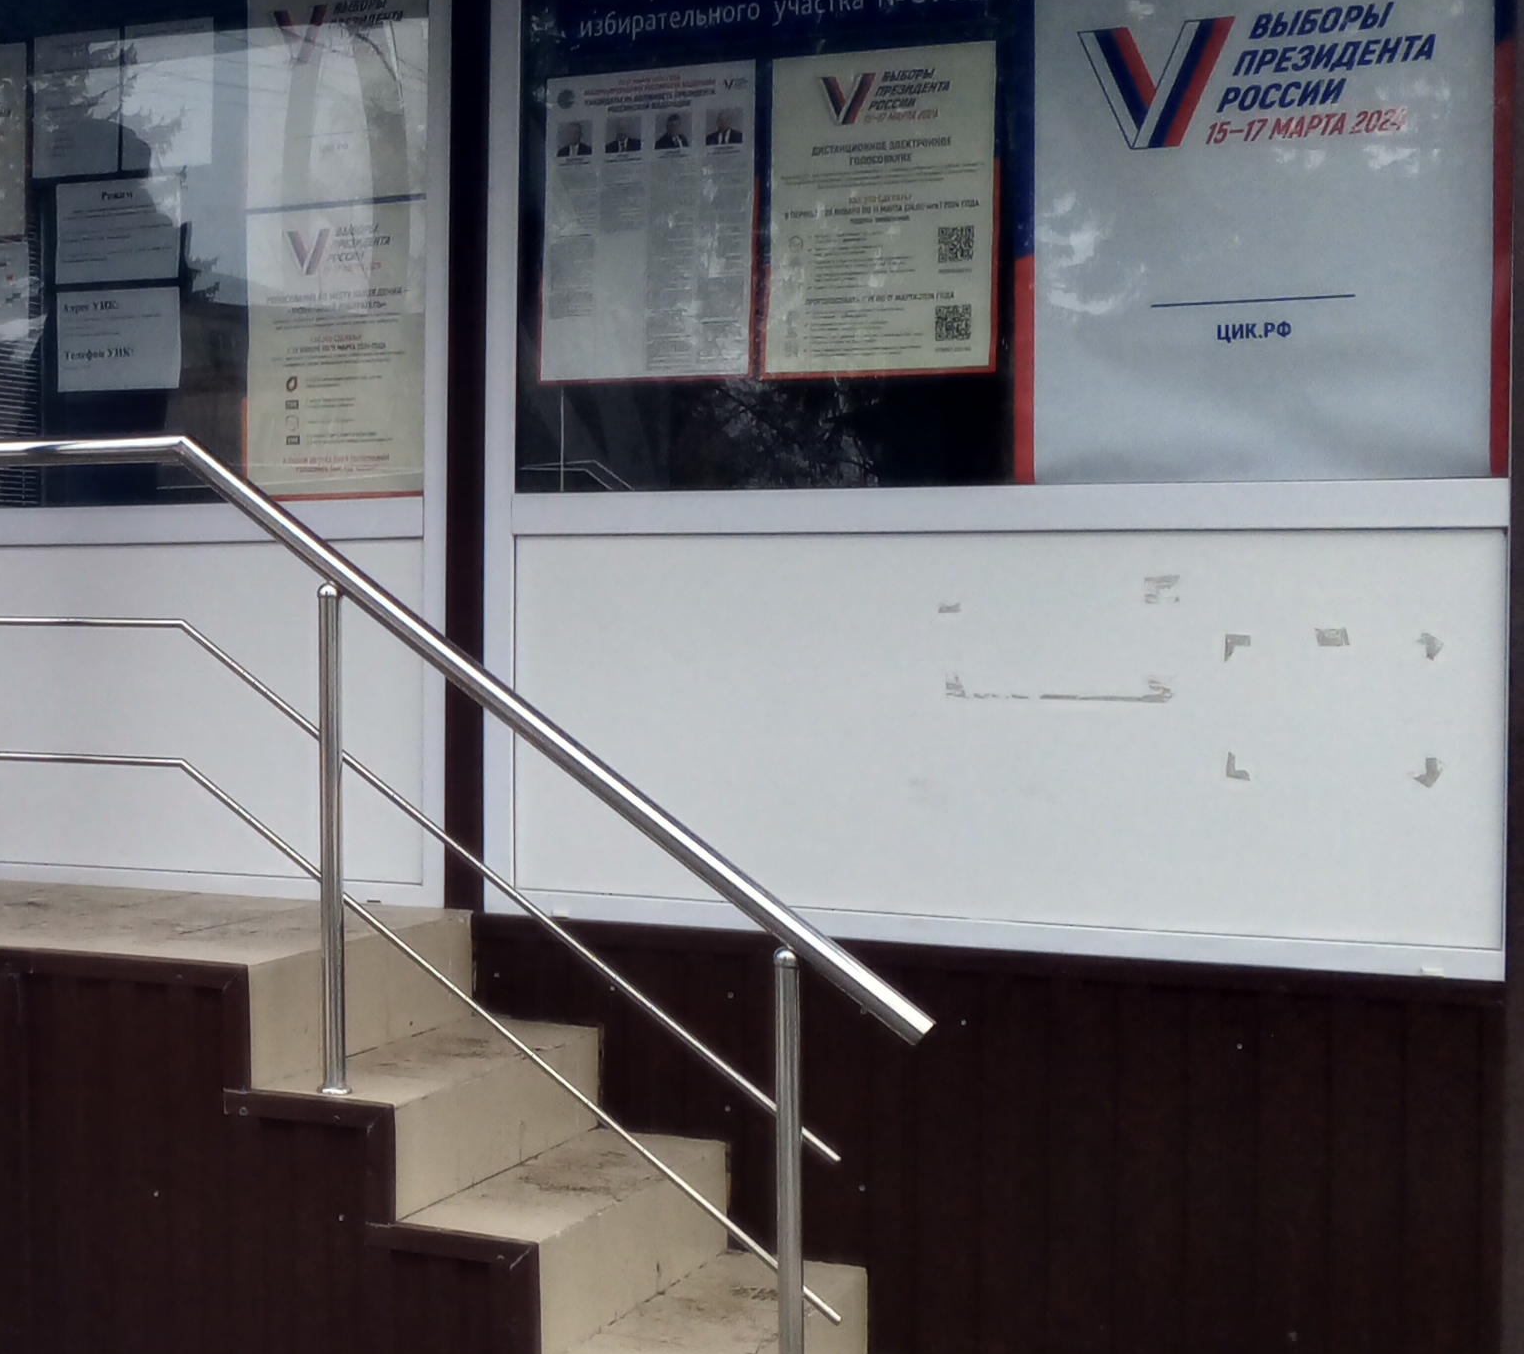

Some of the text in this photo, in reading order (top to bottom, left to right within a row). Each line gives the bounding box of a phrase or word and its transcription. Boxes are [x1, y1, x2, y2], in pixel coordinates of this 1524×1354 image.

[579, 0, 760, 40] избирательного
[1249, 2, 1394, 39] ВЫБОРЫ
[1233, 34, 1437, 77] ПРЕЗИДЕНТА
[874, 81, 950, 97] ПРЕЗИДЕНТА
[882, 69, 935, 82] ВЫБОРЫ
[868, 98, 917, 111] РОССИИ
[1217, 78, 1347, 113] РОССИИ
[1269, 112, 1347, 140] МАРТА
[1216, 321, 1292, 342] ЦИК.РФ
